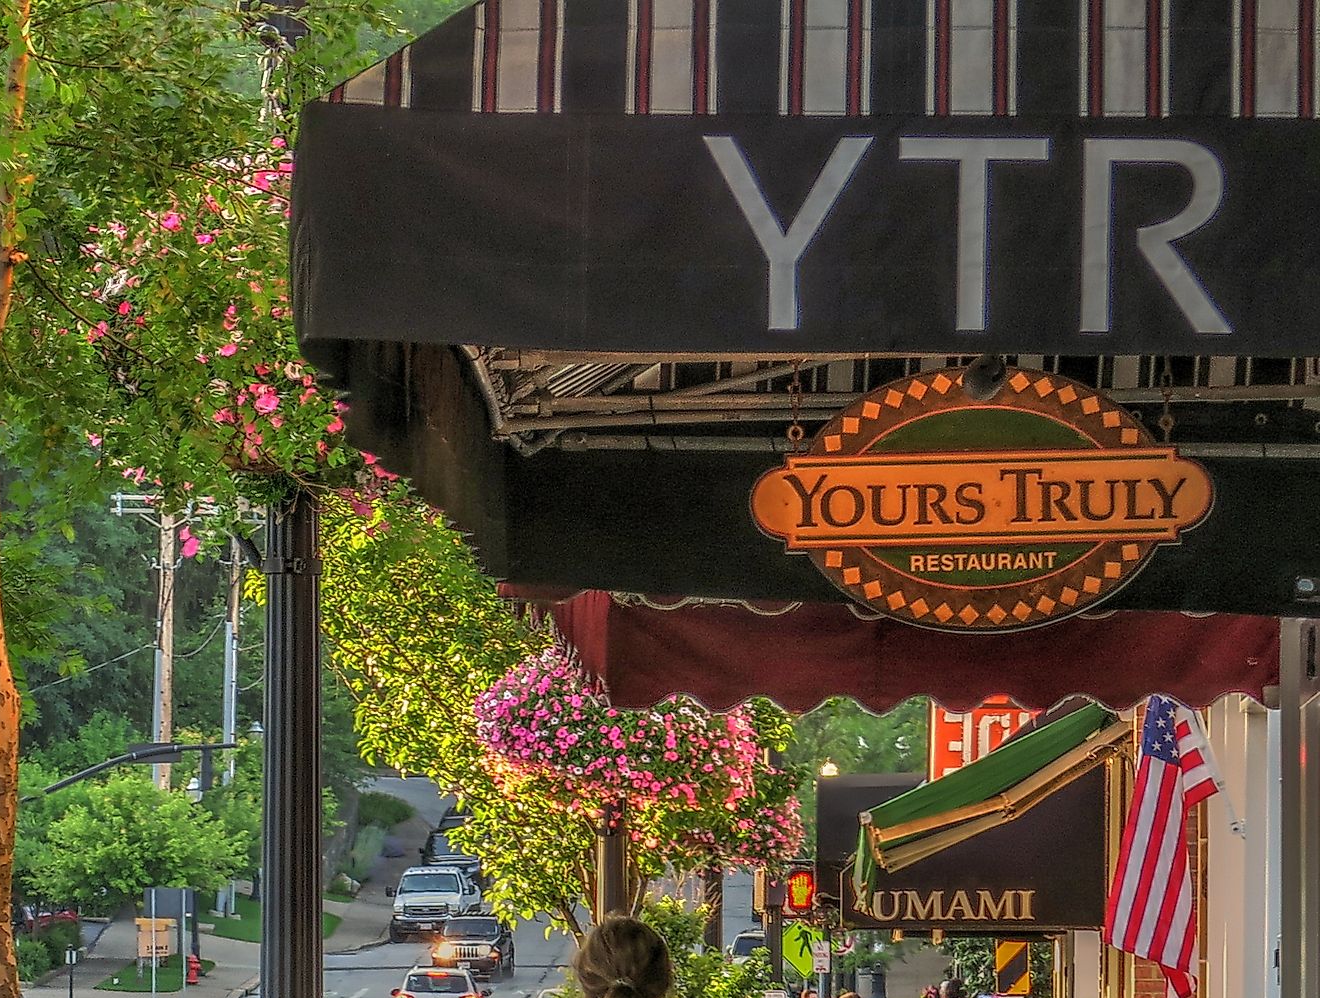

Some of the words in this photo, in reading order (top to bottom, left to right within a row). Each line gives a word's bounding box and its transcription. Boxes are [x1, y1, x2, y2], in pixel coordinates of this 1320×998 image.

[702, 134, 1233, 334] YTR
[783, 473, 986, 528] YOURS
[999, 468, 1187, 523] TRULY
[909, 551, 1057, 572] RESTAURANT
[872, 889, 1036, 922] UMAMI
